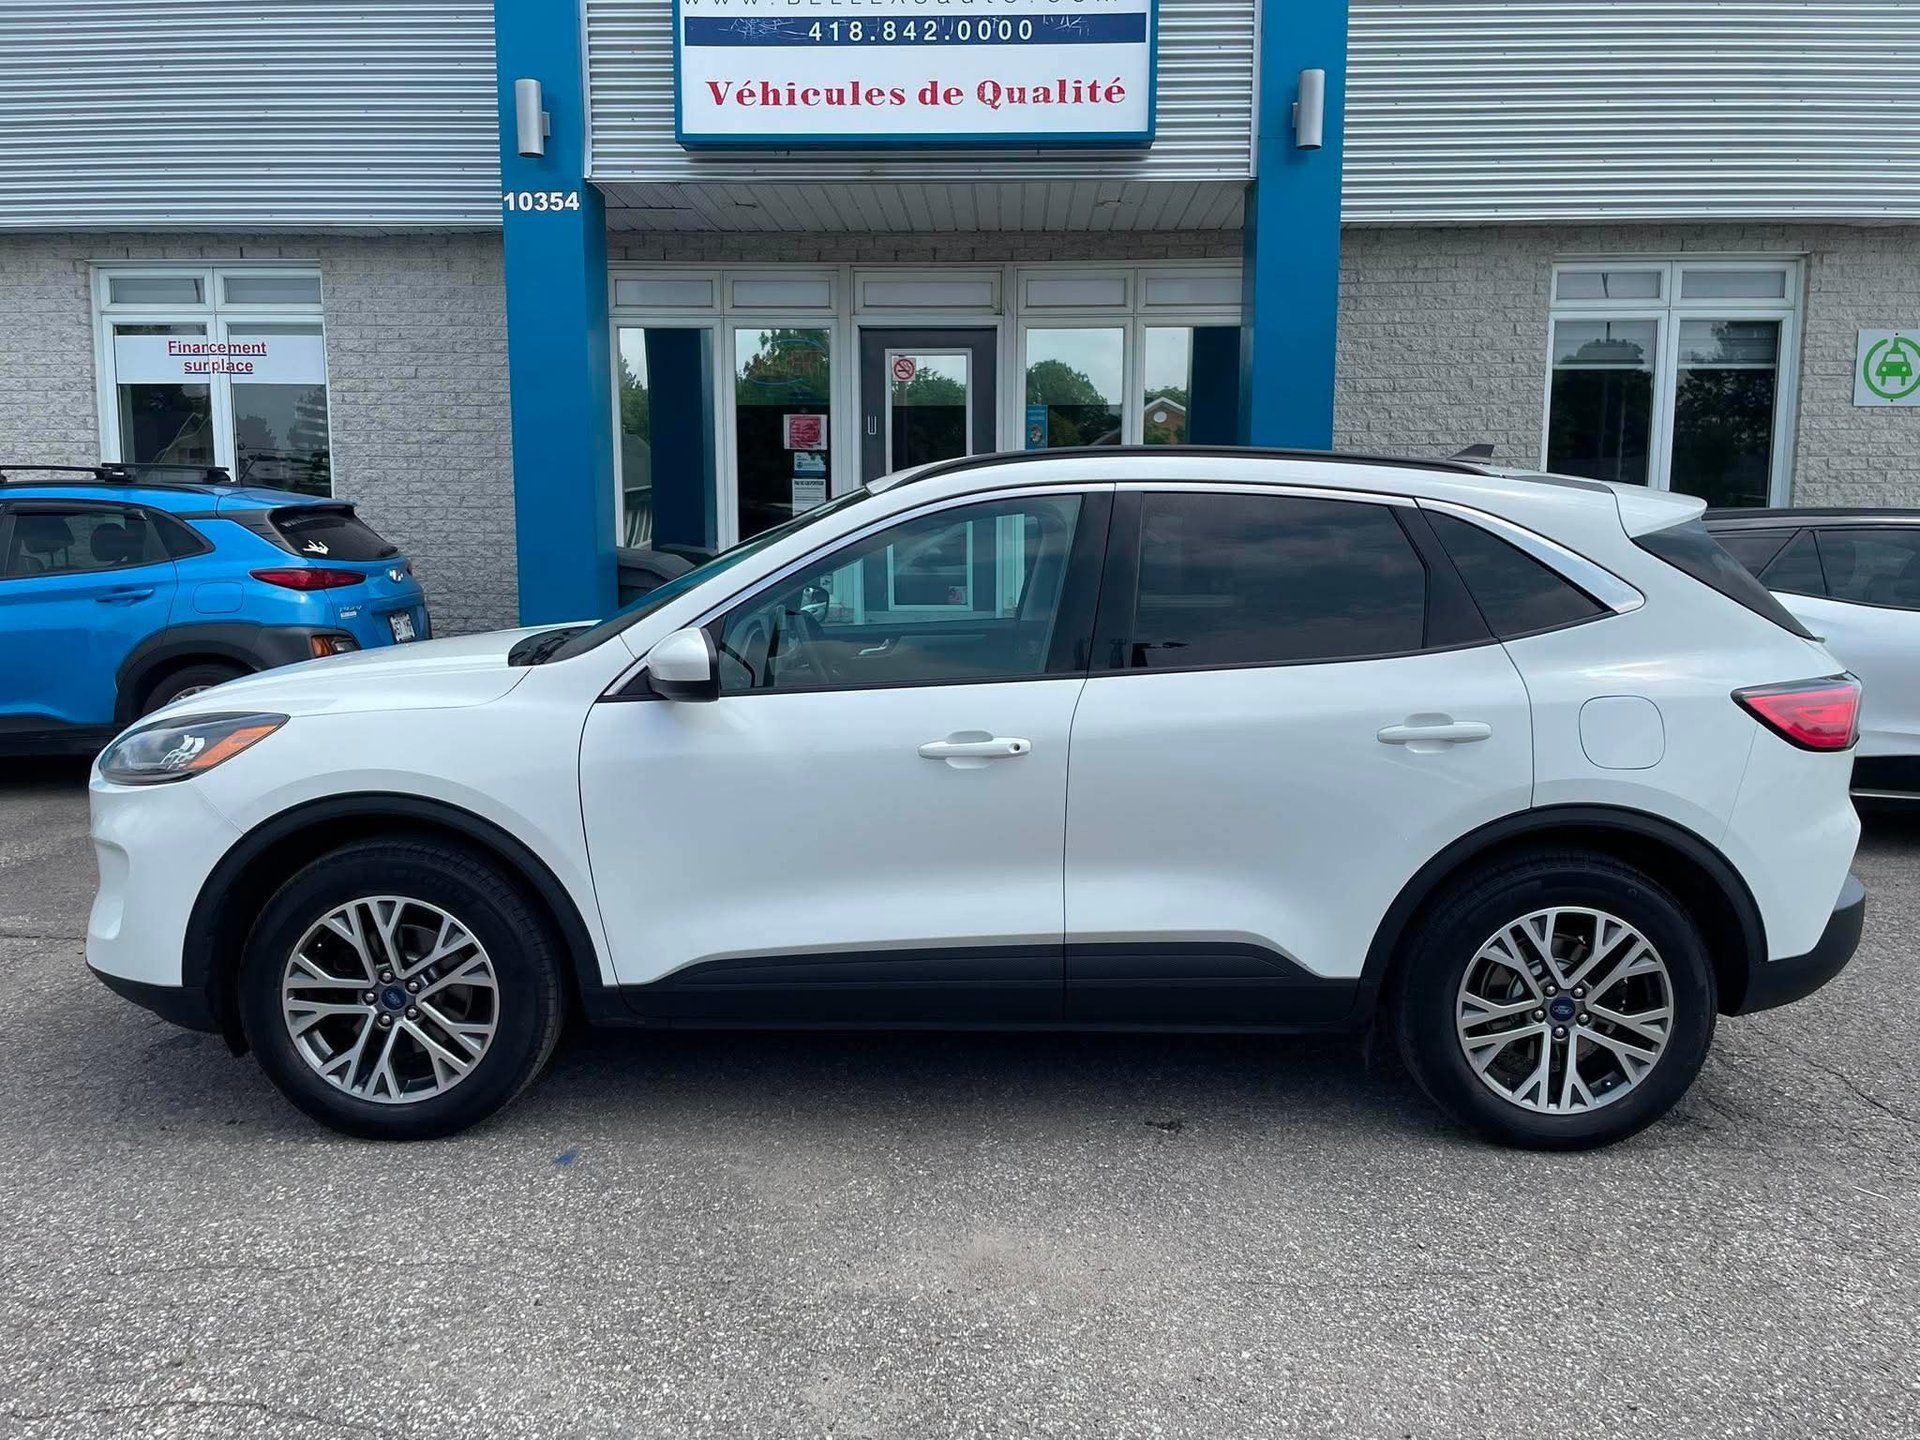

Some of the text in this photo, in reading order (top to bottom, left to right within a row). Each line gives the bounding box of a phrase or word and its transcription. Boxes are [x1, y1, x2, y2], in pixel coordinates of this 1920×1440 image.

[808, 19, 1033, 41] 418.842.0000
[705, 77, 1126, 110] Véhicules de Qualité
[503, 191, 580, 211] 10354
[168, 340, 267, 354] Financement
